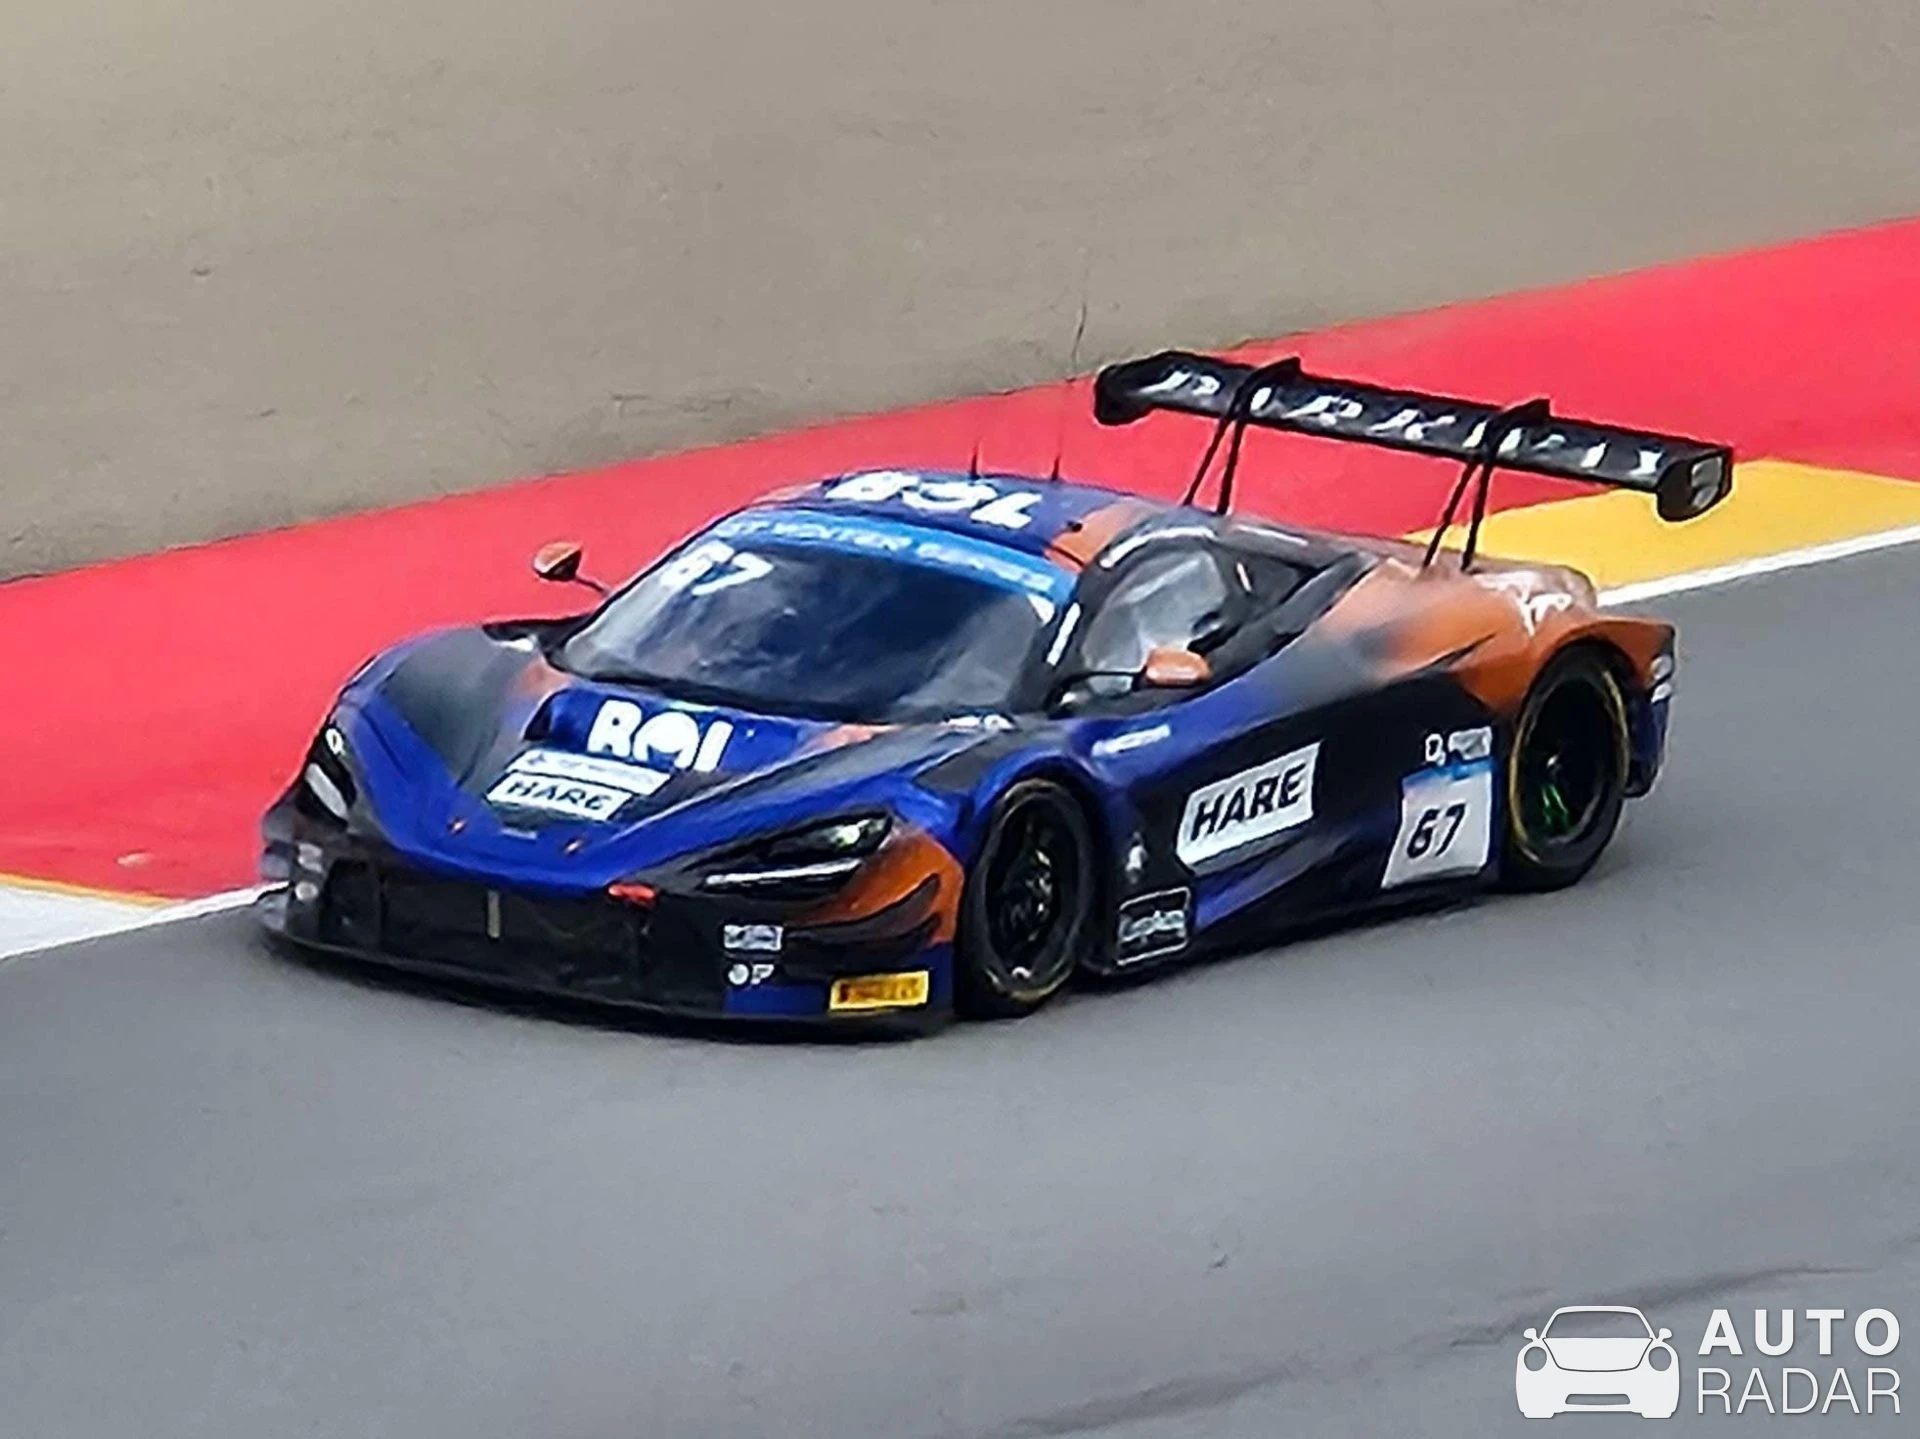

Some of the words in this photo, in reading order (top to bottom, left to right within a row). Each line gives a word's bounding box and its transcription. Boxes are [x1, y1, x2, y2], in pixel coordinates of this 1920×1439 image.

[506, 781, 613, 811] HARE
[1190, 763, 1306, 842] HARE
[1406, 803, 1467, 860] 67
